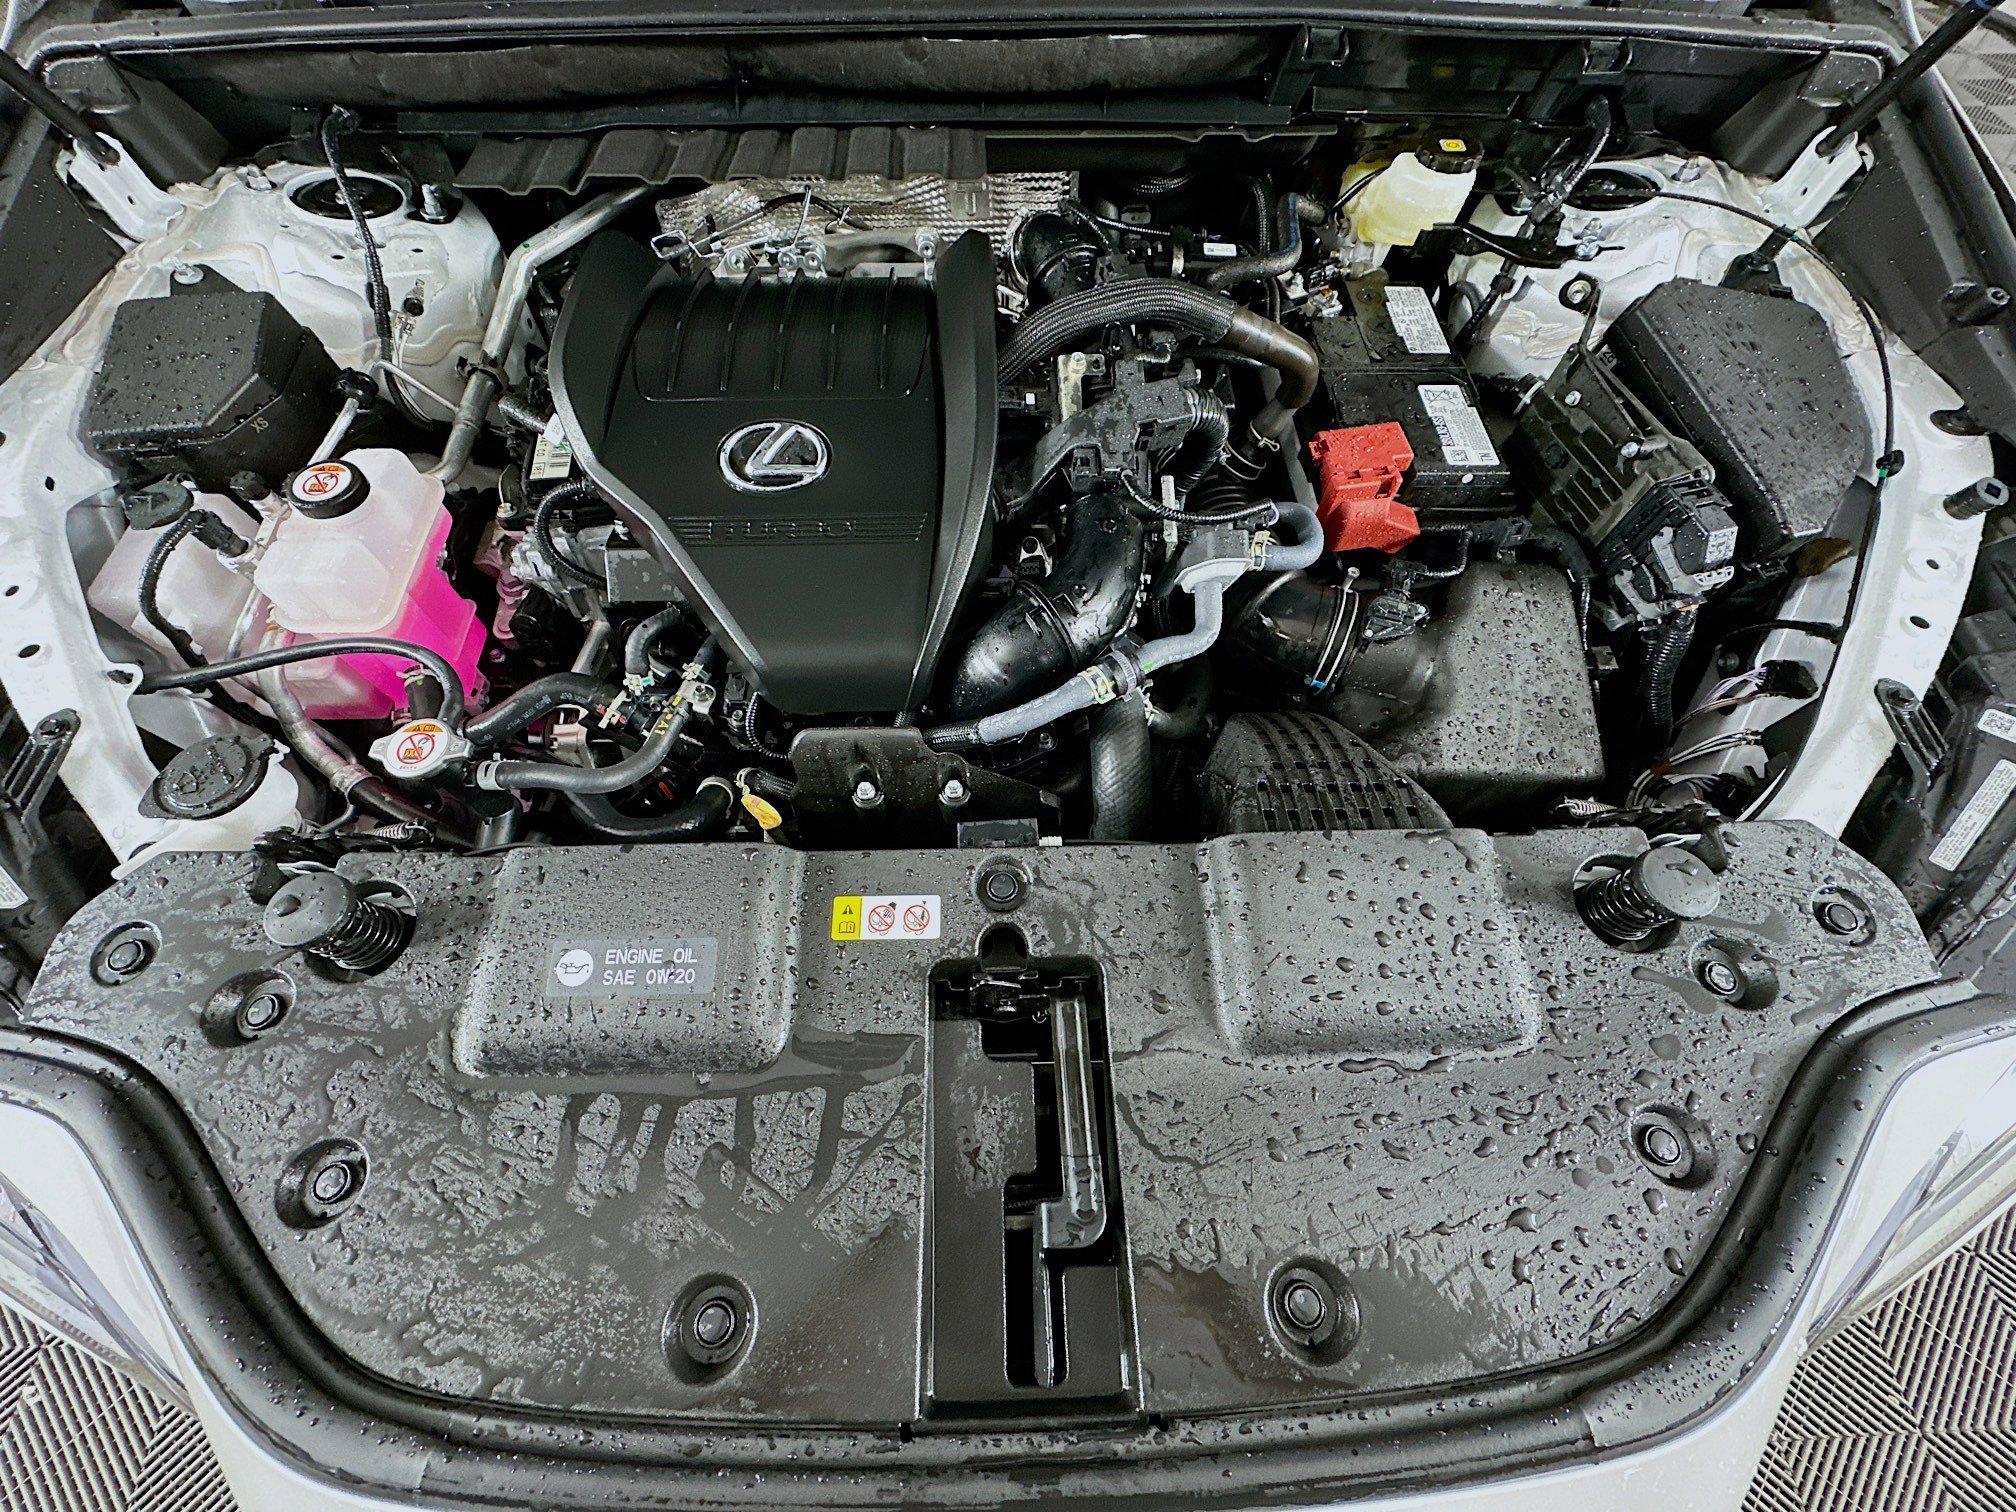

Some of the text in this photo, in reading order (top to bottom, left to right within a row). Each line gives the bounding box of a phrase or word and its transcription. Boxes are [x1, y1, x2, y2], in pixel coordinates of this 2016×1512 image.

[250, 416, 269, 433] XS
[714, 520, 852, 538] TURBO
[604, 947, 698, 965] ENGINE OIL
[602, 967, 696, 986] SAE 0W-20
